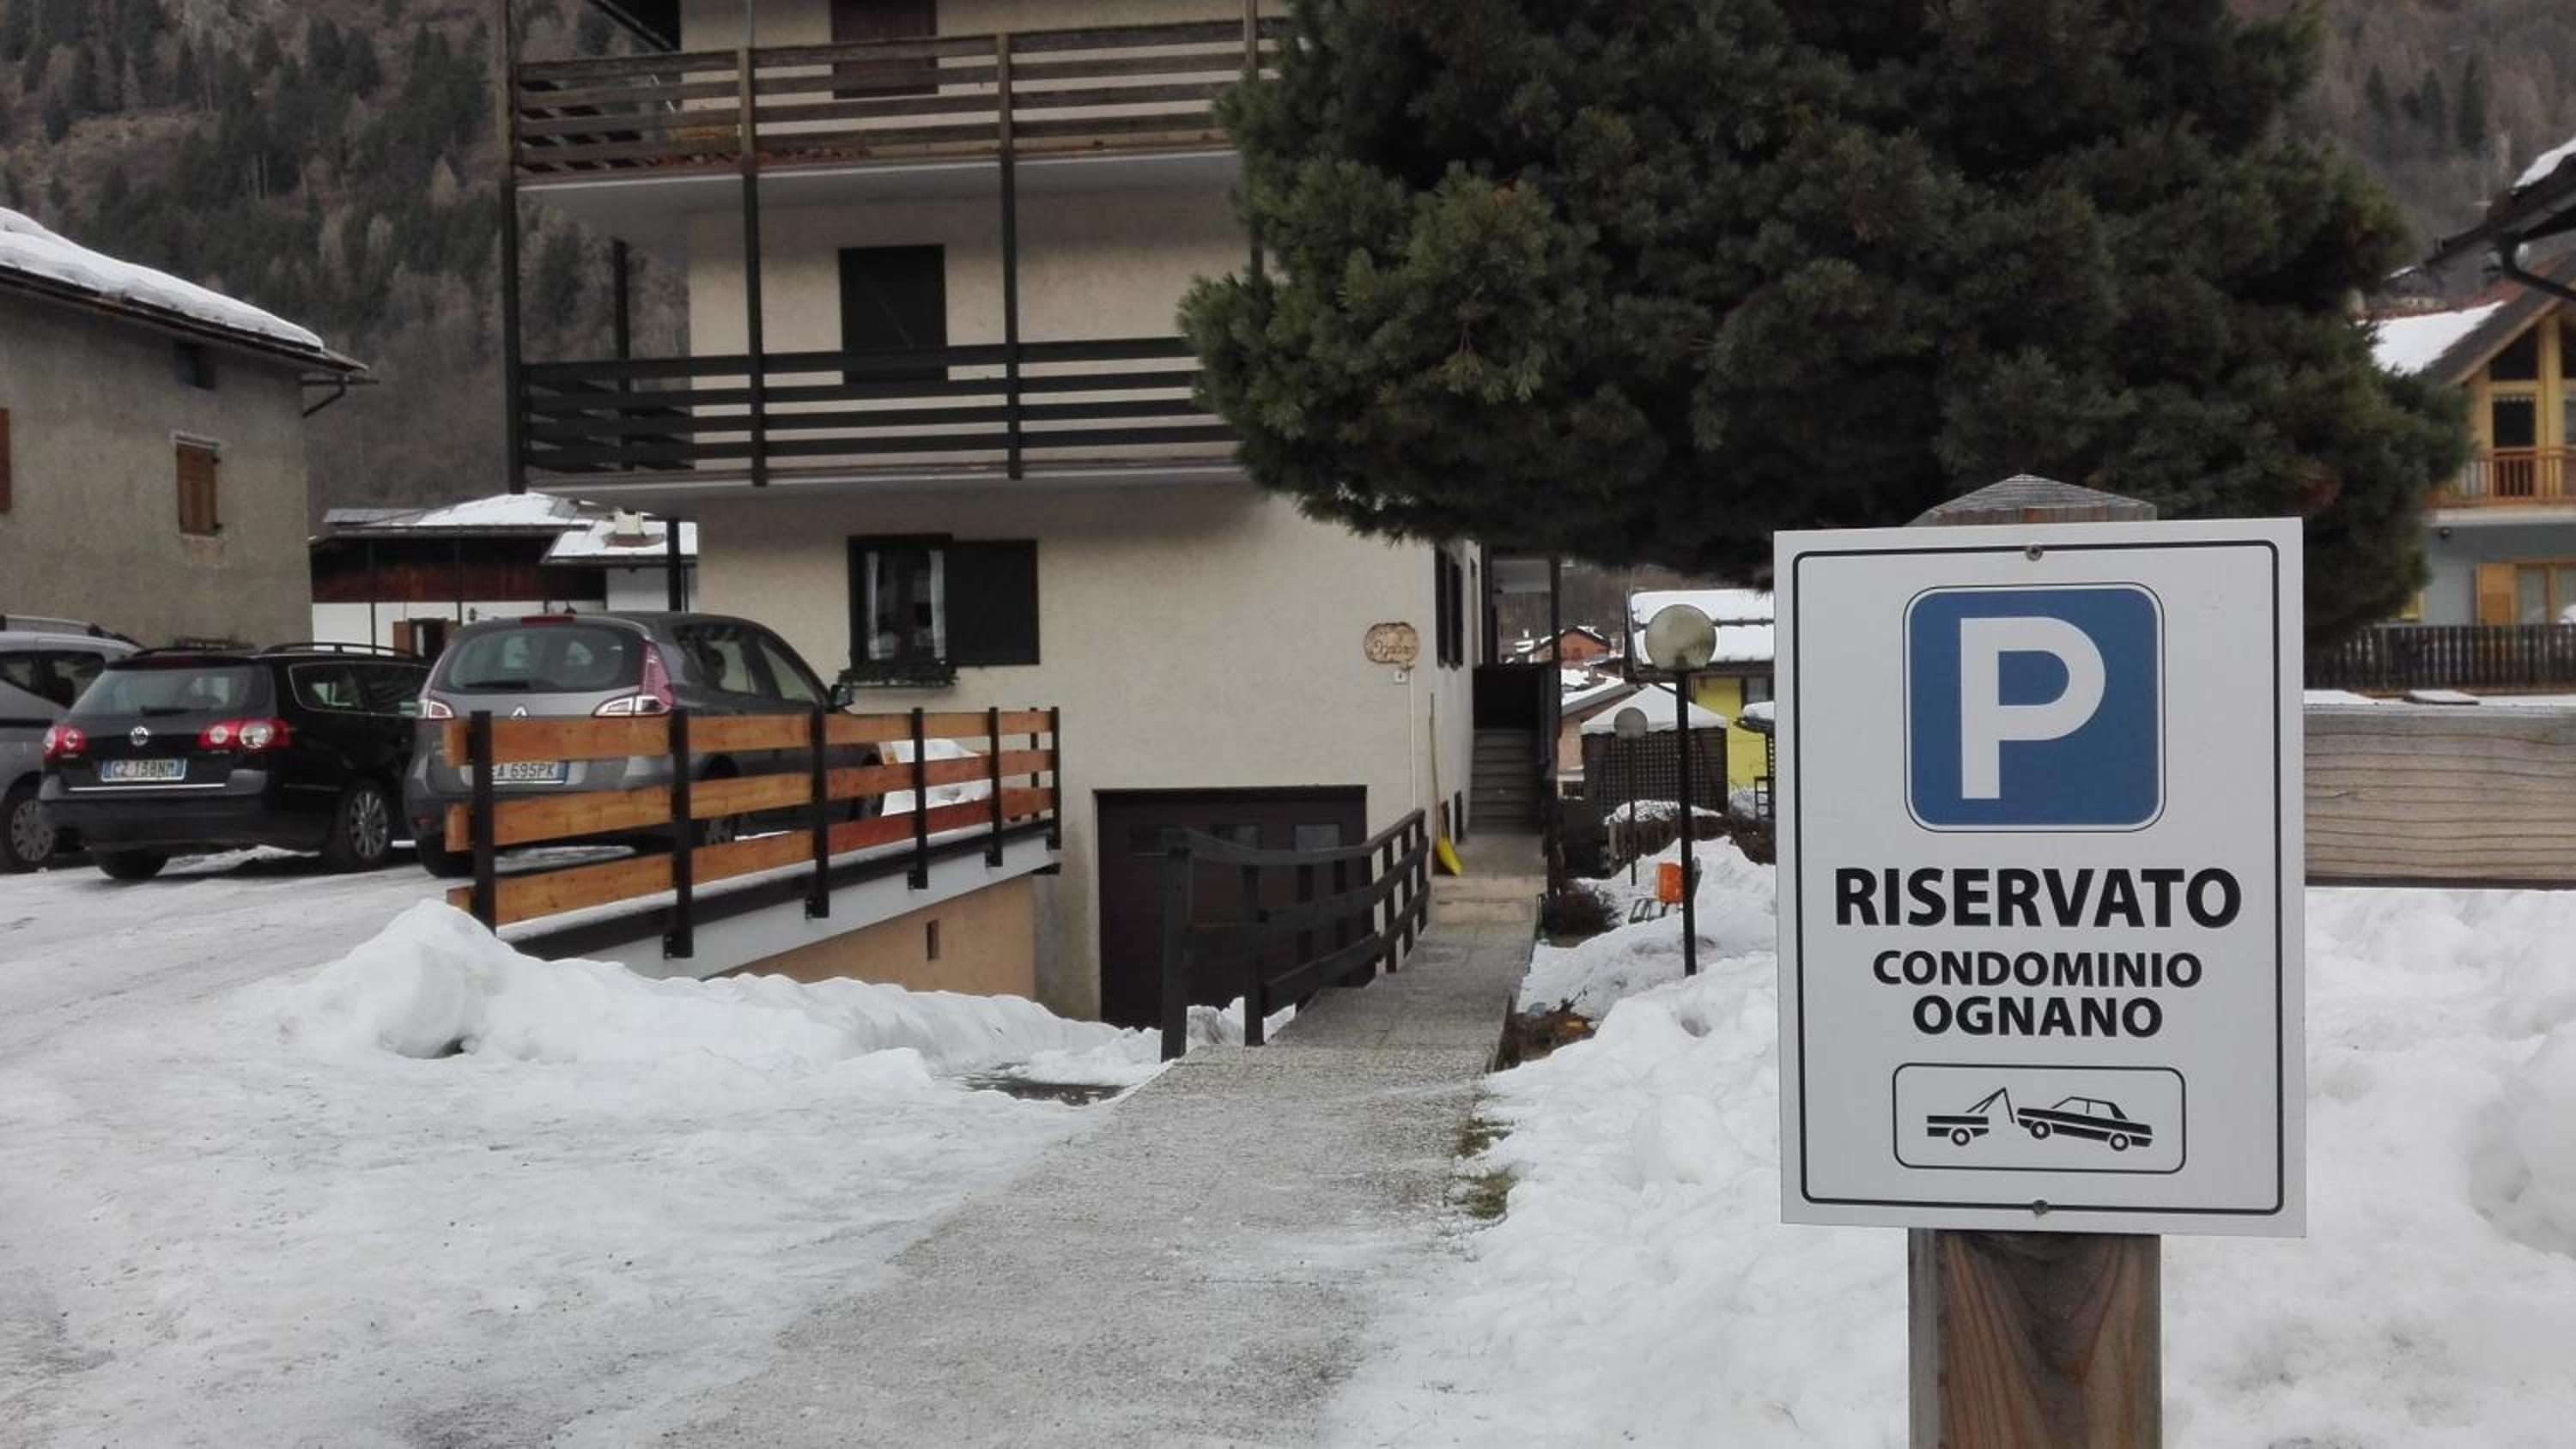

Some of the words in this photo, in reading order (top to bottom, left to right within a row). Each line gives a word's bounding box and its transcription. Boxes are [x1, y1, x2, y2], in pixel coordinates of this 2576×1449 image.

[1960, 615, 2106, 799] P
[1835, 867, 2242, 929] RISERVATO
[1873, 949, 2202, 988] CONDOMINIO
[1912, 994, 2163, 1038] OGNANO
